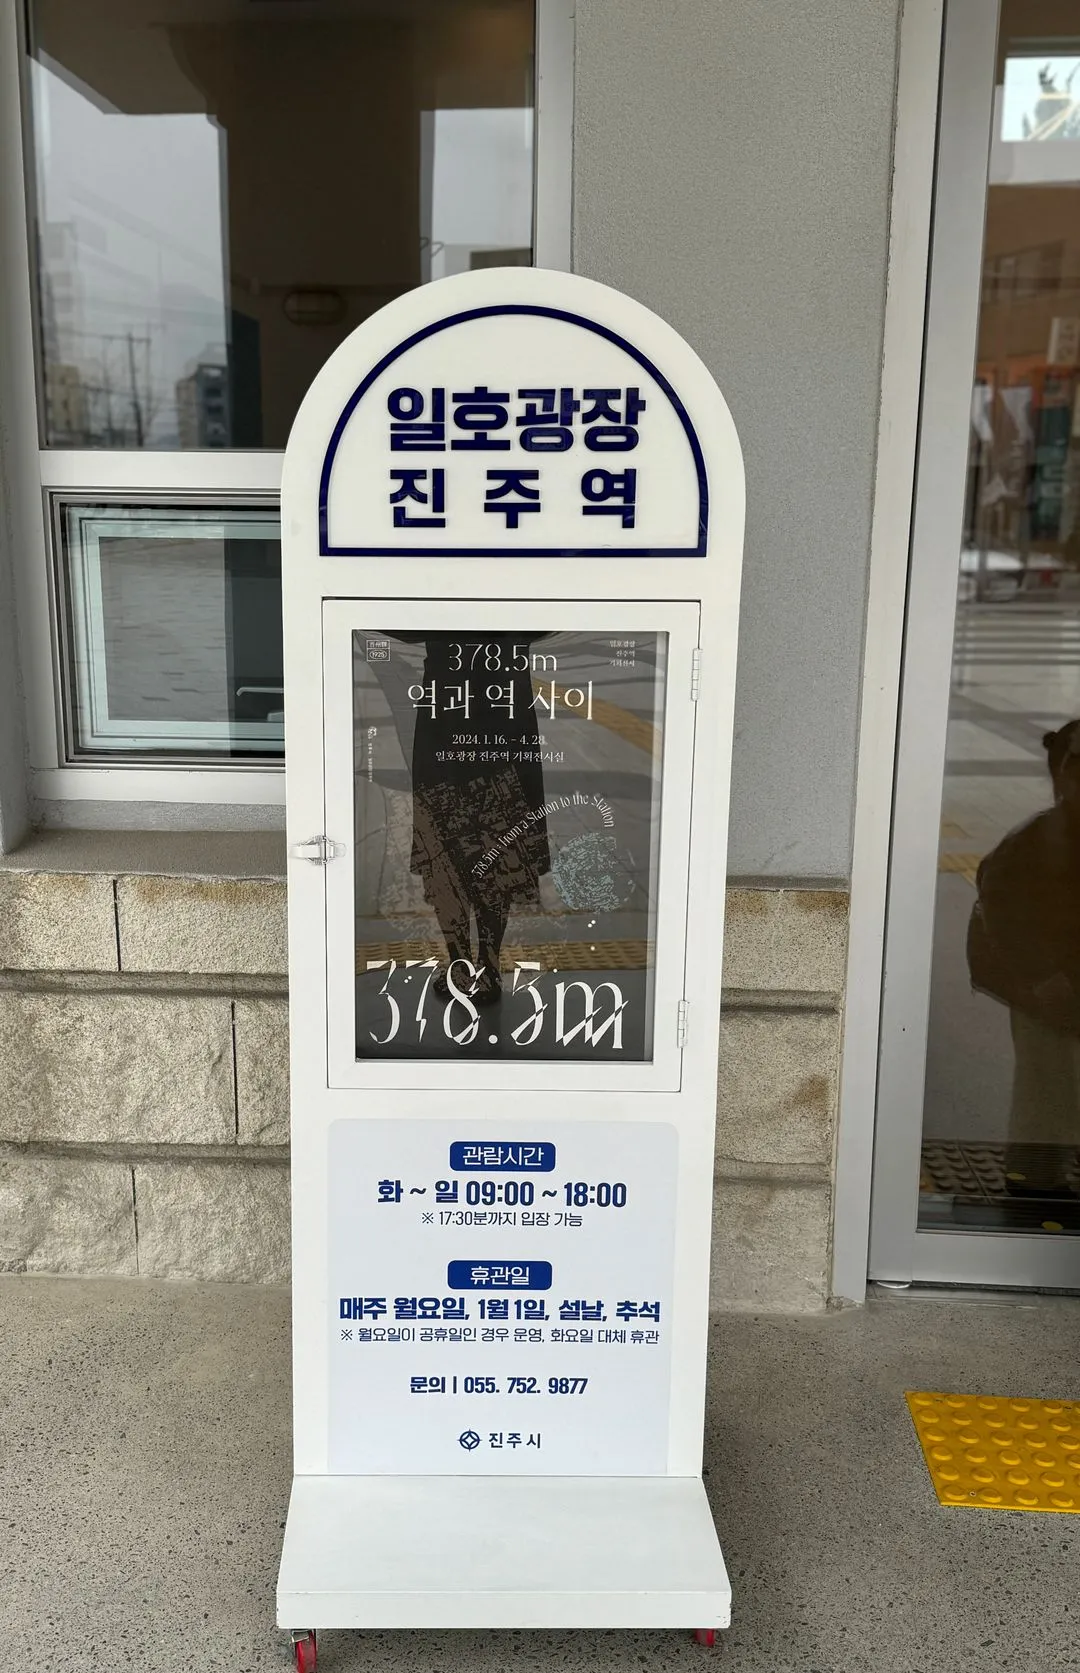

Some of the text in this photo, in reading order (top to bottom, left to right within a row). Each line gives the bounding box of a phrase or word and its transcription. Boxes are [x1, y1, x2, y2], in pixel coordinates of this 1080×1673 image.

[387, 386, 647, 453] 일호광장
[448, 643, 558, 672] 378.5m
[407, 679, 593, 721] 역과 역 사이
[452, 734, 481, 745] 2024.
[519, 734, 529, 745] 4.
[435, 750, 564, 763] 일호광장 진주역 기획전시실
[471, 848, 500, 879] 378.5m
[526, 801, 561, 825] Station
[366, 957, 629, 1049] 378.5m
[462, 1146, 545, 1166] 관람시간
[377, 1179, 404, 1204] 화
[434, 1179, 459, 1204] 일
[465, 1180, 535, 1207] 09:00
[563, 1181, 627, 1208] 18:00
[438, 1210, 517, 1227] 17:30분까지
[521, 1211, 551, 1227] 입장
[553, 1212, 584, 1227] 가능
[470, 1265, 530, 1286] 휴관일
[339, 1296, 661, 1323] 매주 월요일, 1월 1일, 설날, 추석
[357, 1327, 416, 1342] 월요일이
[419, 1327, 477, 1343] 공휴일인
[480, 1327, 510, 1343] 경우
[513, 1327, 545, 1343] 운영,
[550, 1327, 594, 1344] 화요일
[597, 1329, 627, 1344] 대체
[629, 1329, 660, 1345] 휴관
[409, 1376, 446, 1394] 문의
[463, 1376, 501, 1394] 055.
[506, 1376, 541, 1394] 752.
[548, 1376, 589, 1395] 9877
[488, 1432, 541, 1449] 진주시
